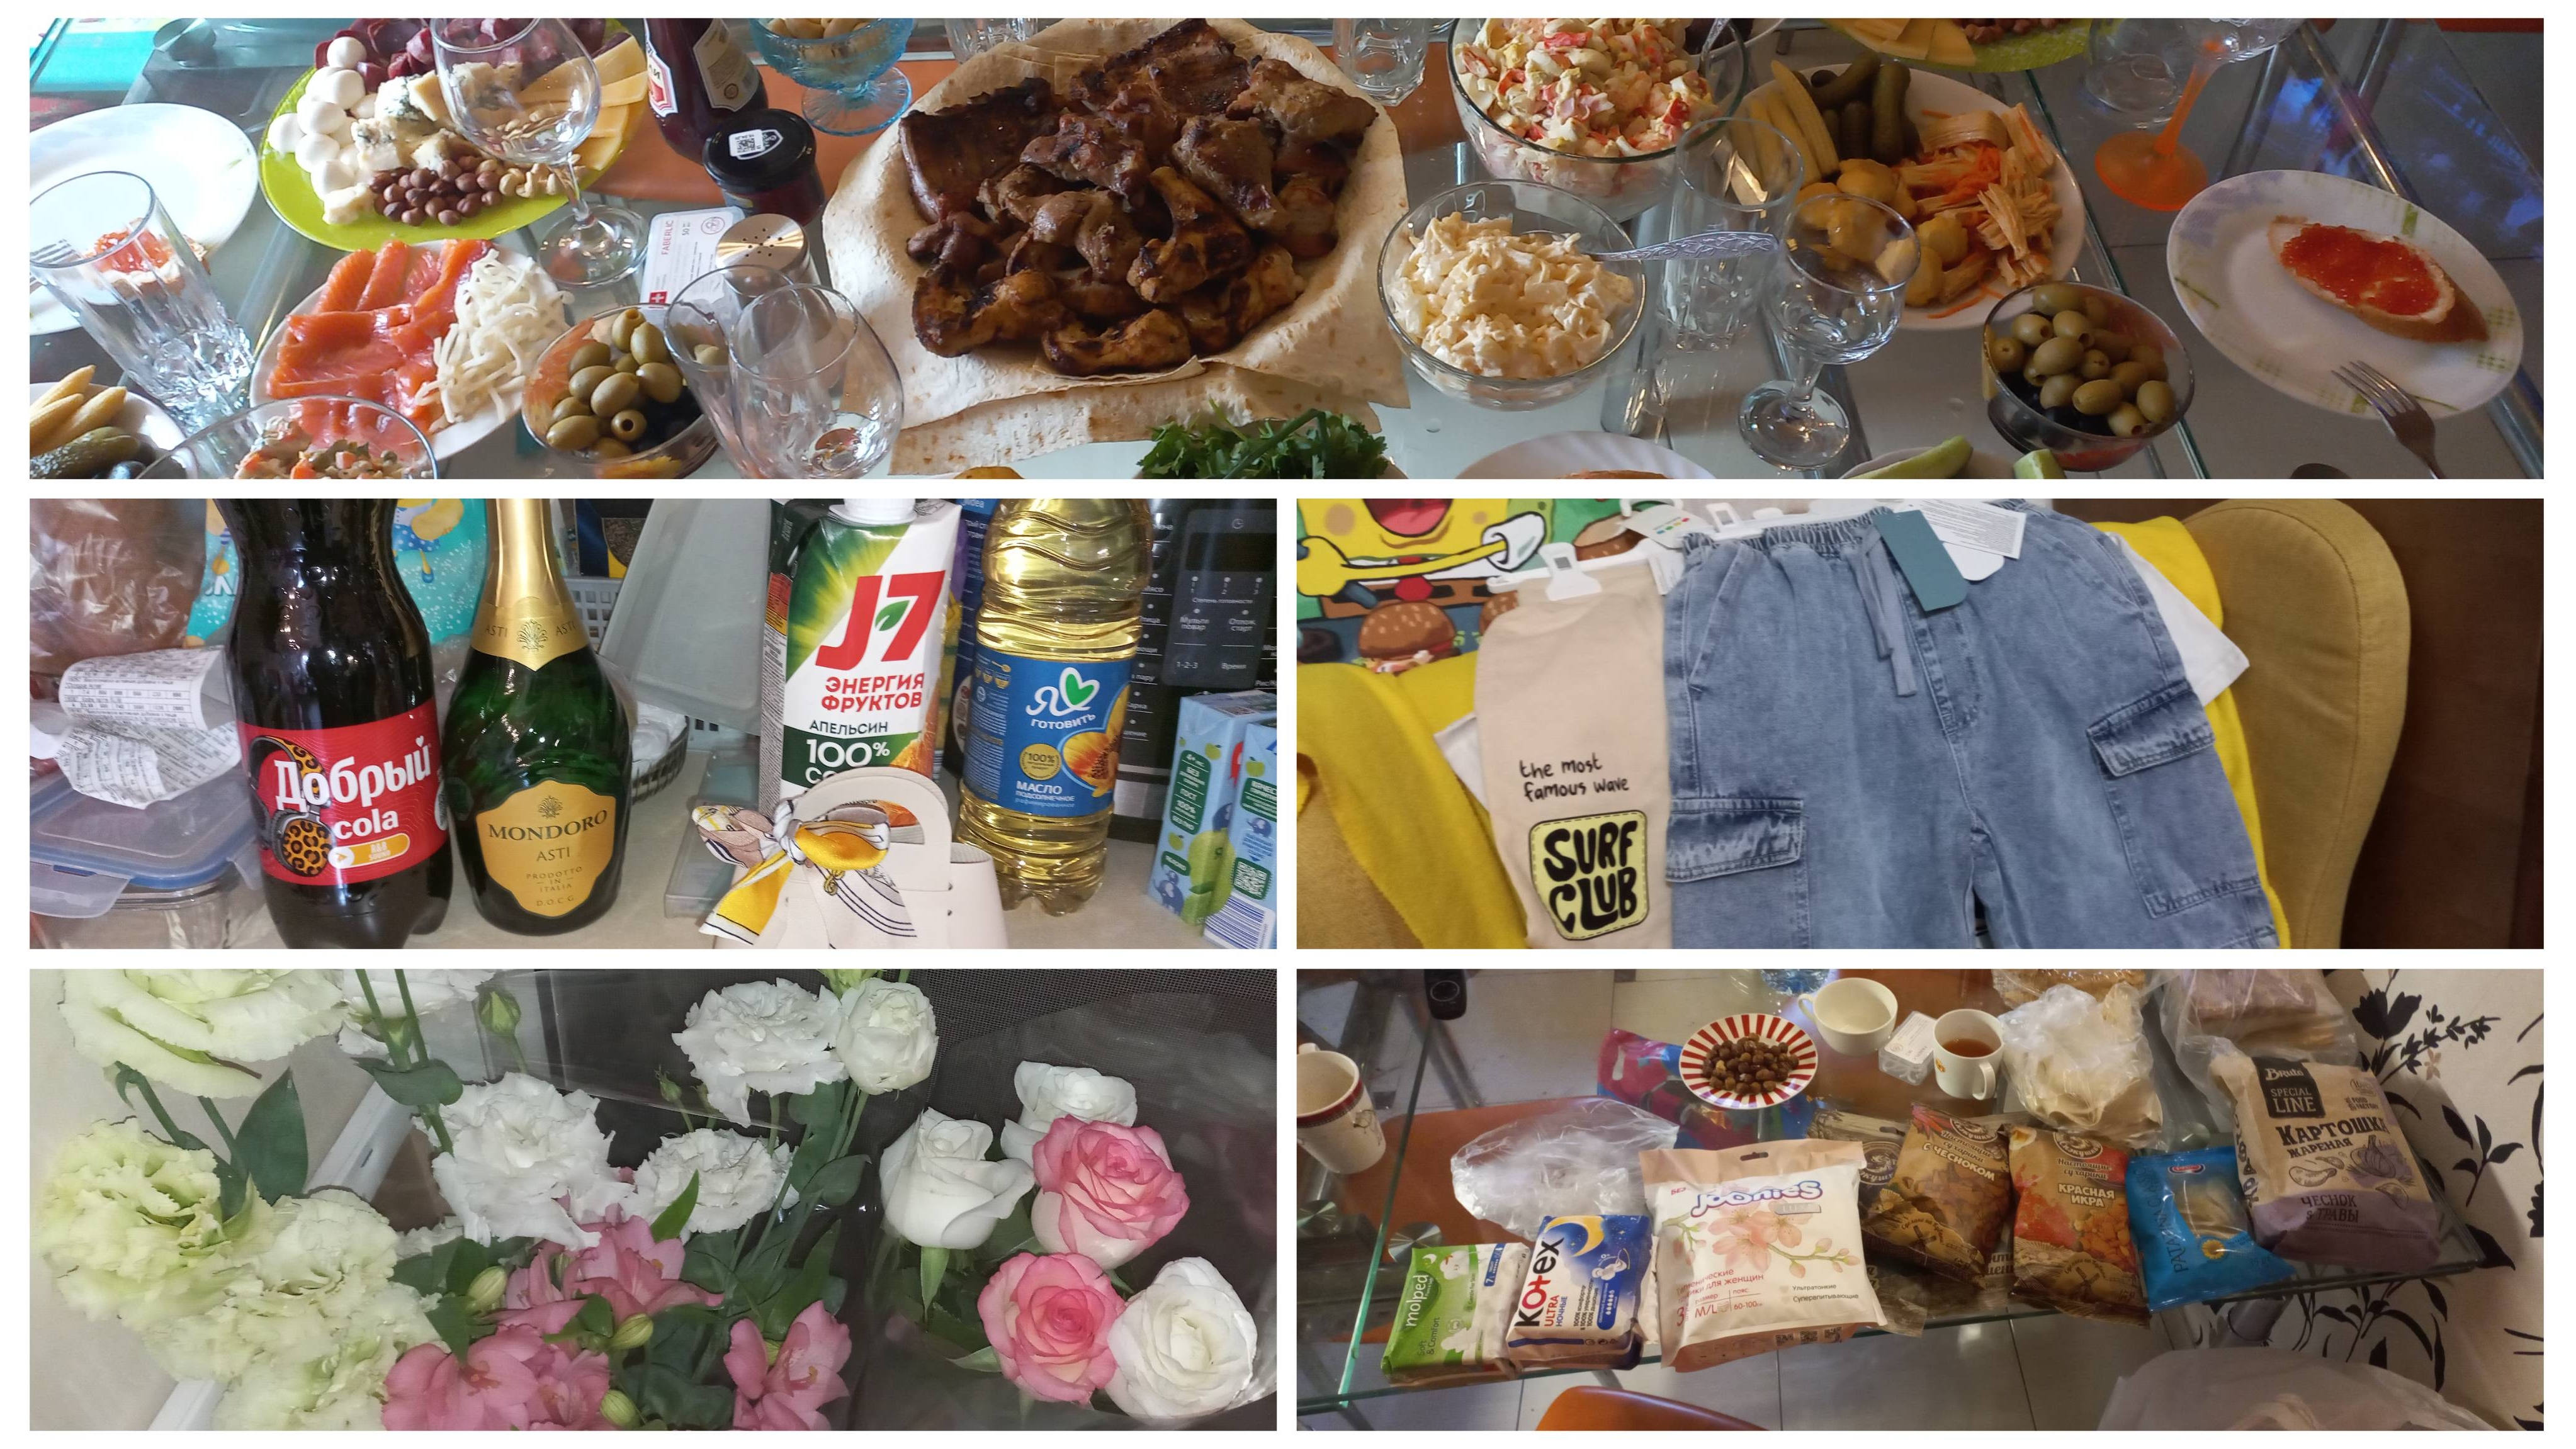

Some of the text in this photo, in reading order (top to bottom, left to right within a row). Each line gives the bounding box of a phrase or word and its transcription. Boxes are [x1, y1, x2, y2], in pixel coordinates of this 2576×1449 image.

[661, 220, 674, 255] FABERLIC
[556, 621, 577, 636] ASTI
[815, 570, 946, 671] J7
[825, 673, 924, 694] ЭНЕРГИЯ
[821, 691, 922, 713] ФРУКТОВ
[809, 720, 888, 735] АПЕЛЬСИН
[1031, 714, 1096, 730] ГОТОВИТЬ
[806, 738, 891, 768] 100%
[1027, 753, 1055, 764] 100%
[274, 735, 431, 813] Добрый
[1519, 752, 1603, 779] the most
[1017, 781, 1063, 795] МАСЛО
[1523, 777, 1630, 802] famous wave
[333, 808, 399, 840] cola
[487, 809, 607, 840] MONDORO
[536, 847, 570, 862] ASTI
[1543, 820, 1638, 882] SURF
[526, 866, 582, 879] PRODOTTO
[539, 883, 572, 893] ITALIA
[1549, 866, 1638, 933] CLUB
[2270, 1087, 2312, 1098] SPECIAL
[2273, 1096, 2317, 1114] LINE
[2275, 1117, 2390, 1147] КАРТОШКА
[2286, 1137, 2354, 1159] ЖАРЕНАЯ
[1923, 1142, 1996, 1181] С ЧЕСНОКОМ
[2057, 1183, 2115, 1199] КРАСНАЯ
[2070, 1195, 2106, 1208] ИКРА
[2301, 1195, 2358, 1208] ЧЕСНОК
[2317, 1208, 2359, 1223] ТРАВЫ
[1514, 1237, 1565, 1327] Kotex
[1724, 1273, 1764, 1286] женщин
[1792, 1283, 1837, 1292] Ультратонкие
[1405, 1274, 1429, 1328] molped
[1793, 1293, 1859, 1303] Супервпитывающие
[1544, 1295, 1560, 1327] ULTRA
[1556, 1295, 1568, 1327] НОЧНЫЕ
[1417, 1339, 1426, 1356] Soft
